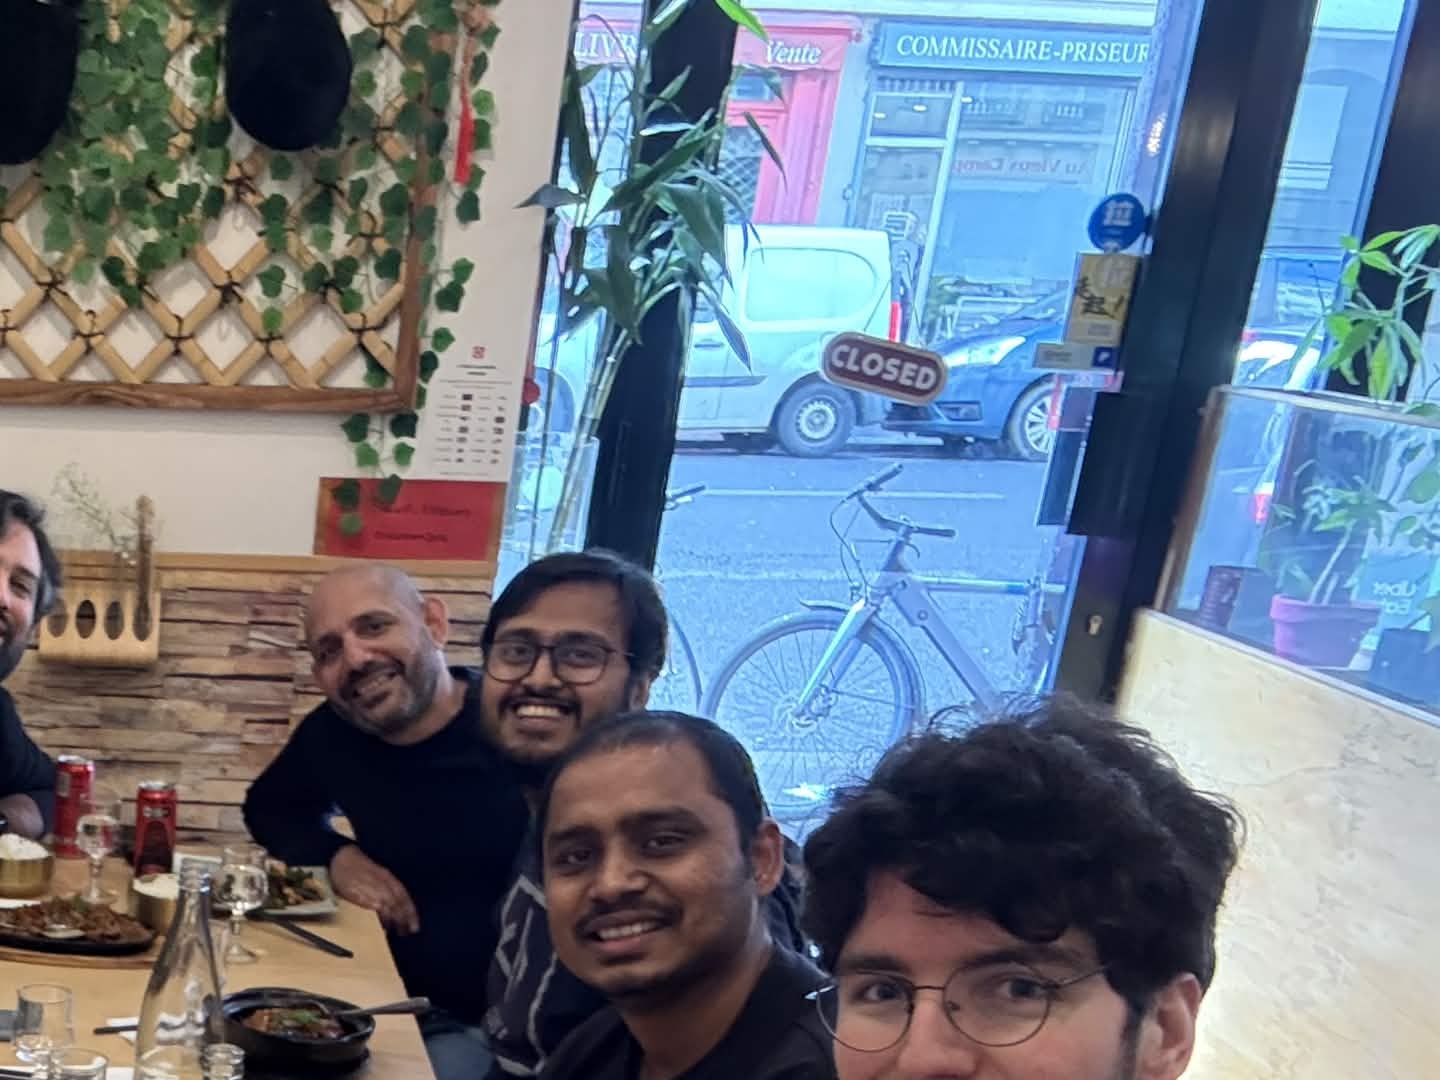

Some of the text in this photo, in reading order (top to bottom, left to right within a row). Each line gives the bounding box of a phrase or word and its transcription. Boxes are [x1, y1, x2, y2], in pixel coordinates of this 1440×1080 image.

[573, 31, 648, 58] LIVR
[766, 40, 822, 65] Vente
[831, 344, 938, 391] CLOSED
